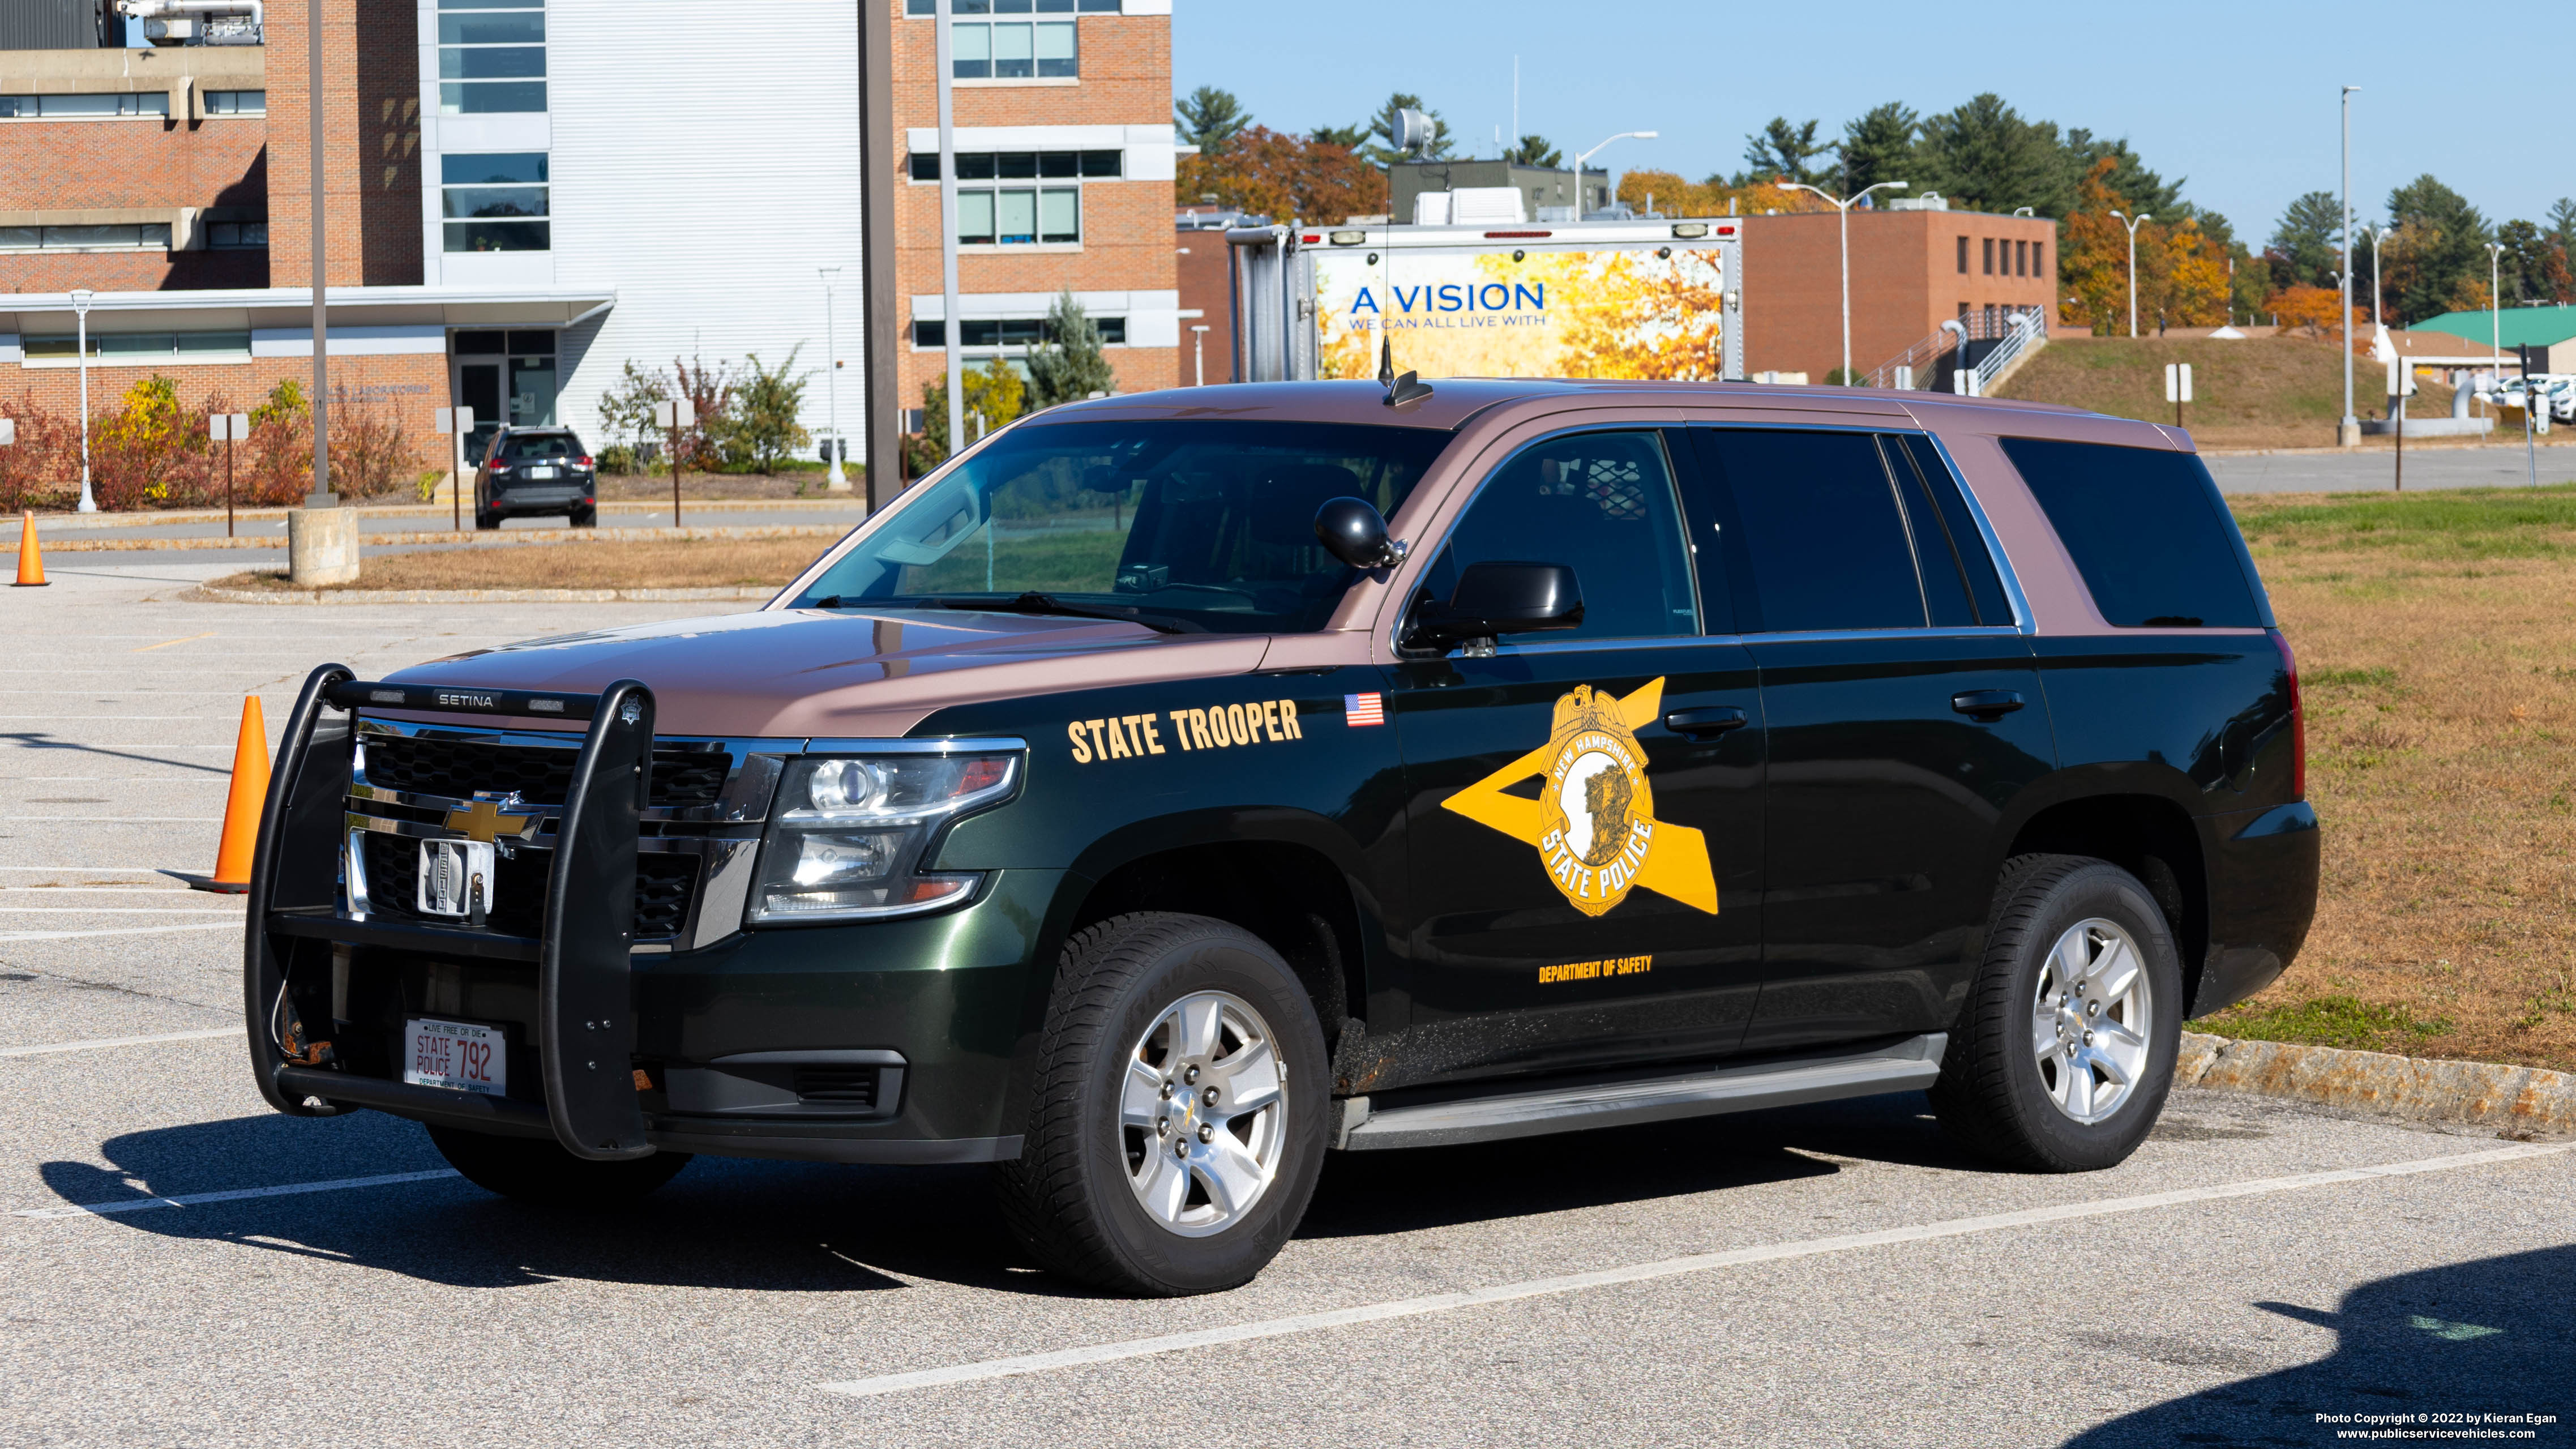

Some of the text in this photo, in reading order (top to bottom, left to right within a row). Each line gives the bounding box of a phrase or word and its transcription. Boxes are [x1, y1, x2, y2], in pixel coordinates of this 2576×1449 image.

[1350, 283, 1544, 314] A VISION
[1349, 315, 1546, 330] WE CAN ALL LIVE WITH
[439, 694, 493, 707] SETINA
[1068, 699, 1302, 763] STATE TROOPER
[1554, 736, 1636, 781] NEW HAMPSHIRE
[1542, 818, 1653, 899] STATE POLICE
[1539, 955, 1653, 984] DEPARTMENT OF SAFETY
[428, 1023, 440, 1033] LIVE
[443, 1025, 458, 1035] FREE
[472, 1029, 481, 1038] DIE
[417, 1035, 451, 1056] STATE
[417, 1055, 451, 1076] POLICE
[457, 1040, 491, 1082] 792
[419, 1078, 454, 1089] DEPARTMENT
[468, 1084, 490, 1093] SAFETY
